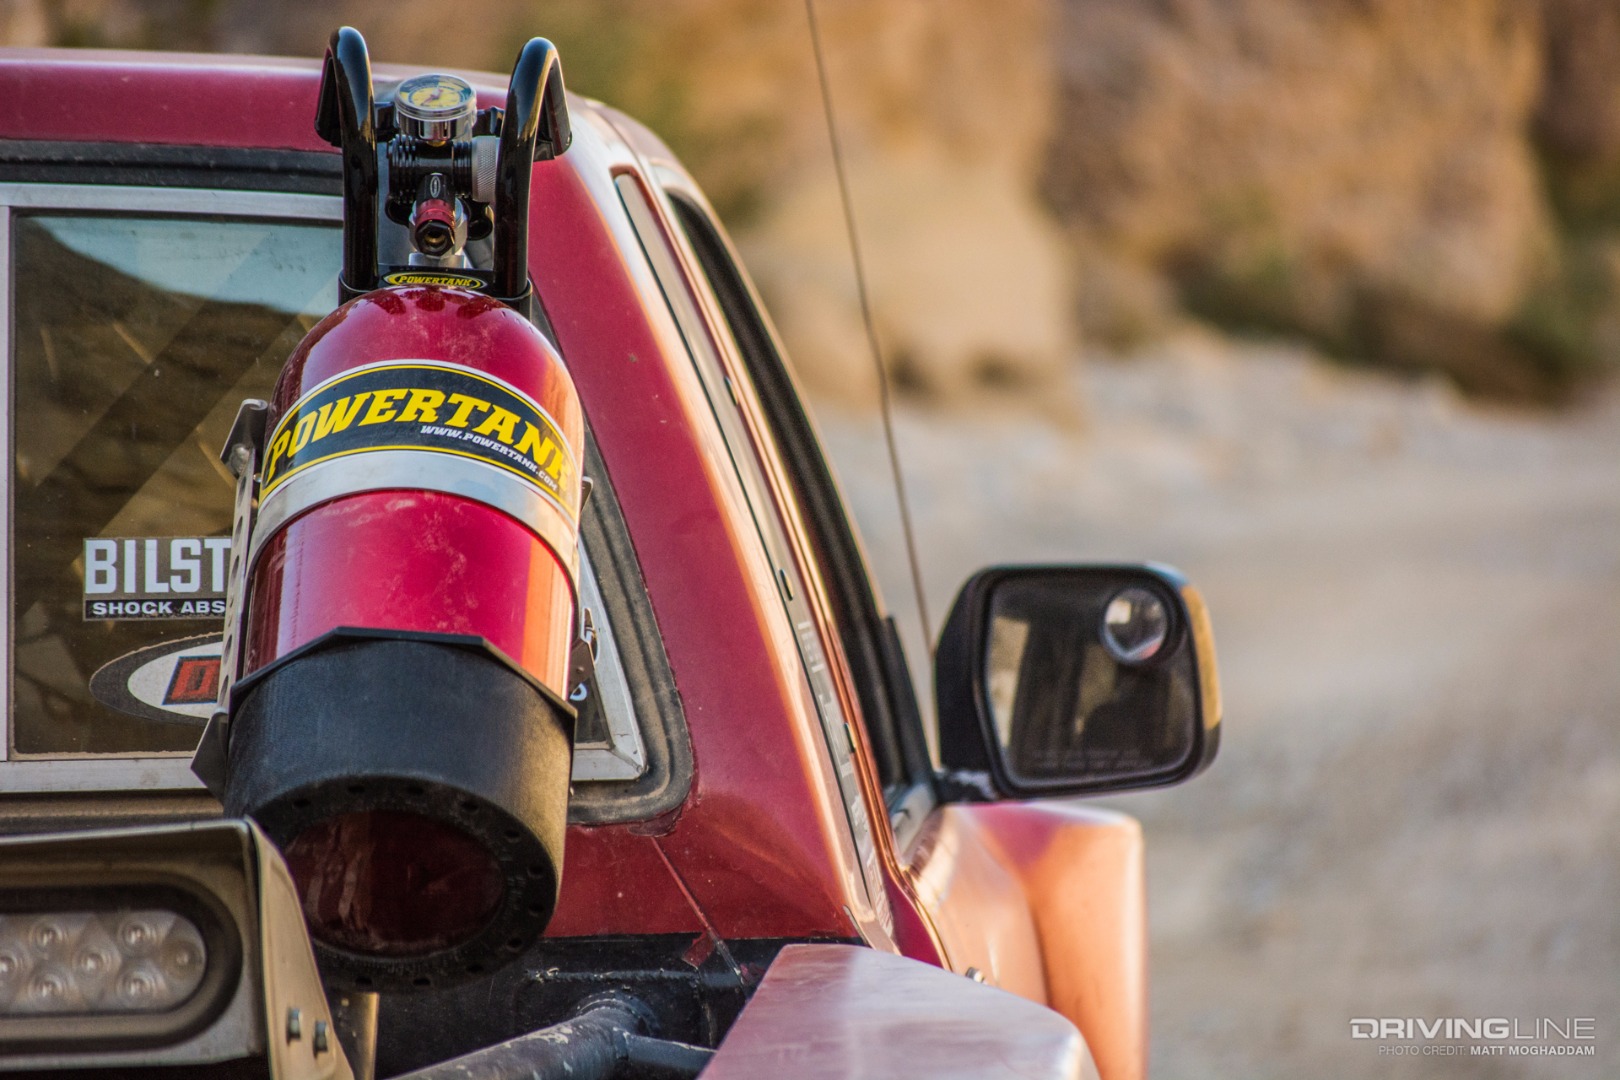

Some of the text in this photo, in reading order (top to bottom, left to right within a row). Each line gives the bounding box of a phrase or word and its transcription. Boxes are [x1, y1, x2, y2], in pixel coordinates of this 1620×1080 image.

[398, 274, 473, 287] POWERTANK
[265, 388, 571, 491] POWERTANK
[420, 425, 558, 491] WWW.POWERTANK.COM
[85, 539, 232, 593] BILST
[92, 601, 173, 615] SHOCK
